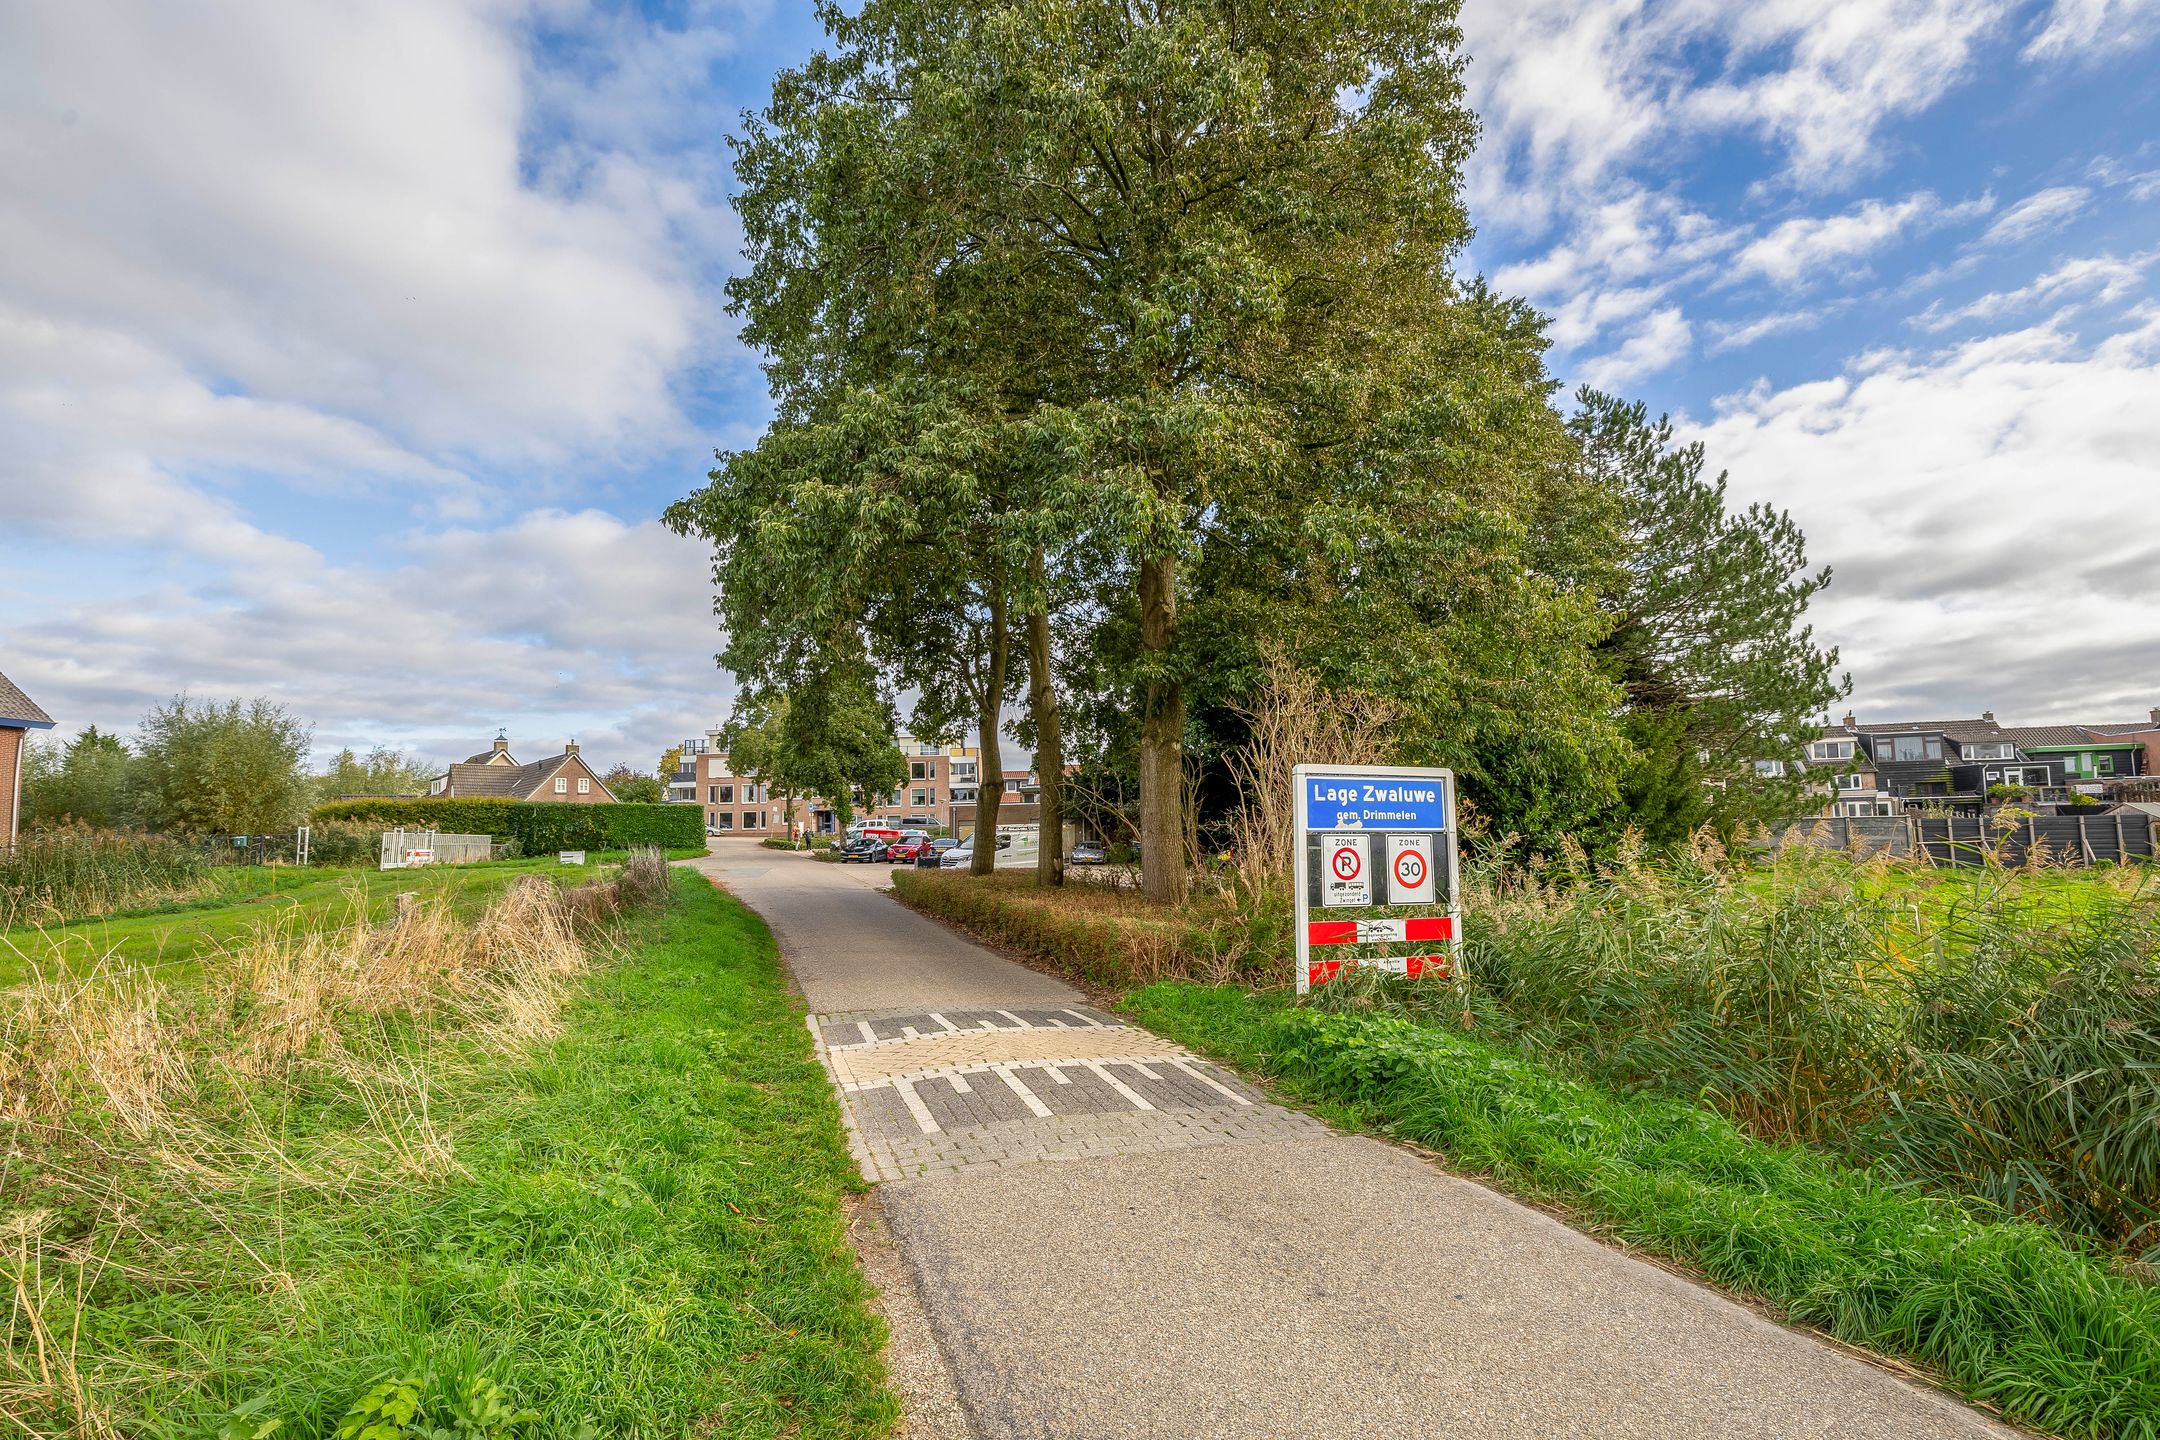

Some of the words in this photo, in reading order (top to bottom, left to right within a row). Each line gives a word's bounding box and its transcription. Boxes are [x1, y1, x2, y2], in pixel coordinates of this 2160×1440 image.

[1314, 785, 1358, 806] Lage
[1362, 785, 1436, 803] Zwaluwe
[1337, 811, 1360, 821] gem.
[1363, 810, 1417, 820] Drimmelen
[1335, 838, 1358, 847] ZONE
[1398, 839, 1420, 847] ZONE
[1400, 862, 1421, 877] 30
[1362, 893, 1369, 903] P
